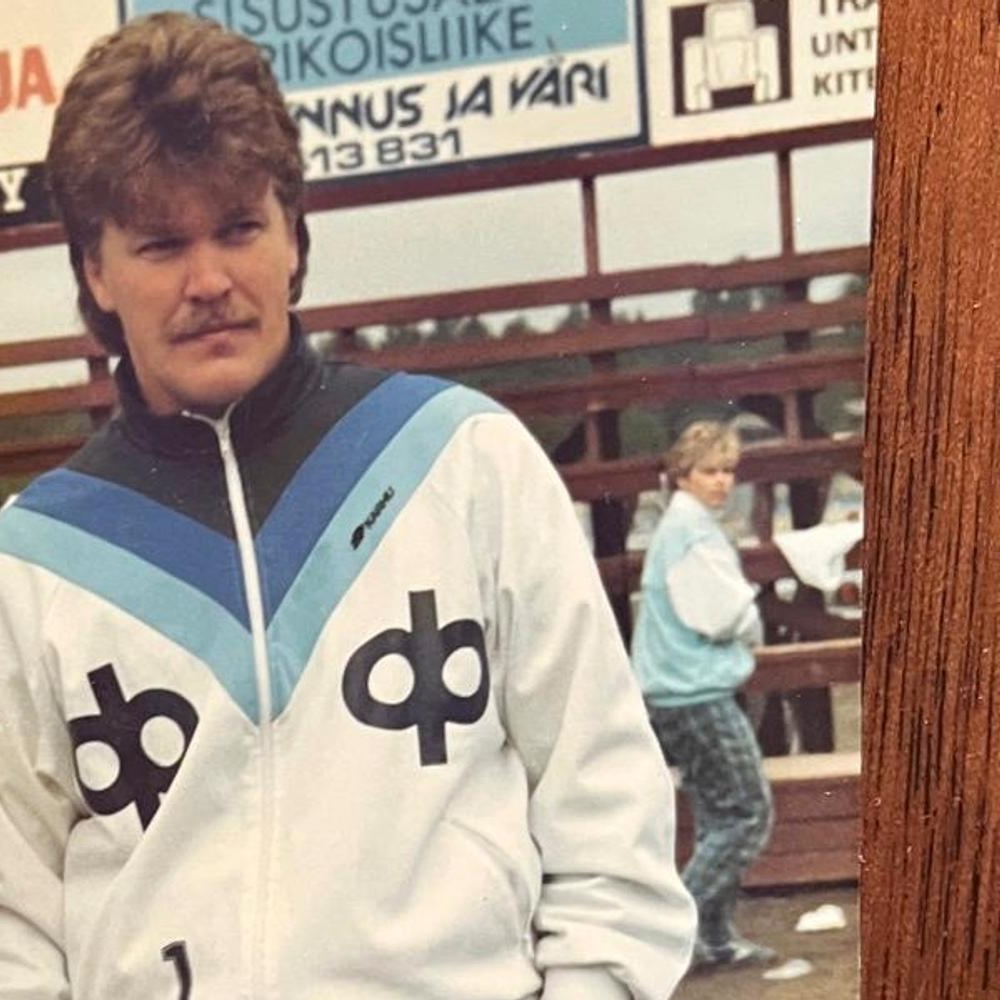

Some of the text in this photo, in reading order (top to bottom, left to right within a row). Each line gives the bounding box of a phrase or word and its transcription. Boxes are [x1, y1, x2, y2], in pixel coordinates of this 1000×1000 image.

[811, 26, 875, 58] UNT
[446, 75, 493, 121] JA
[302, 128, 462, 173] 13 831
